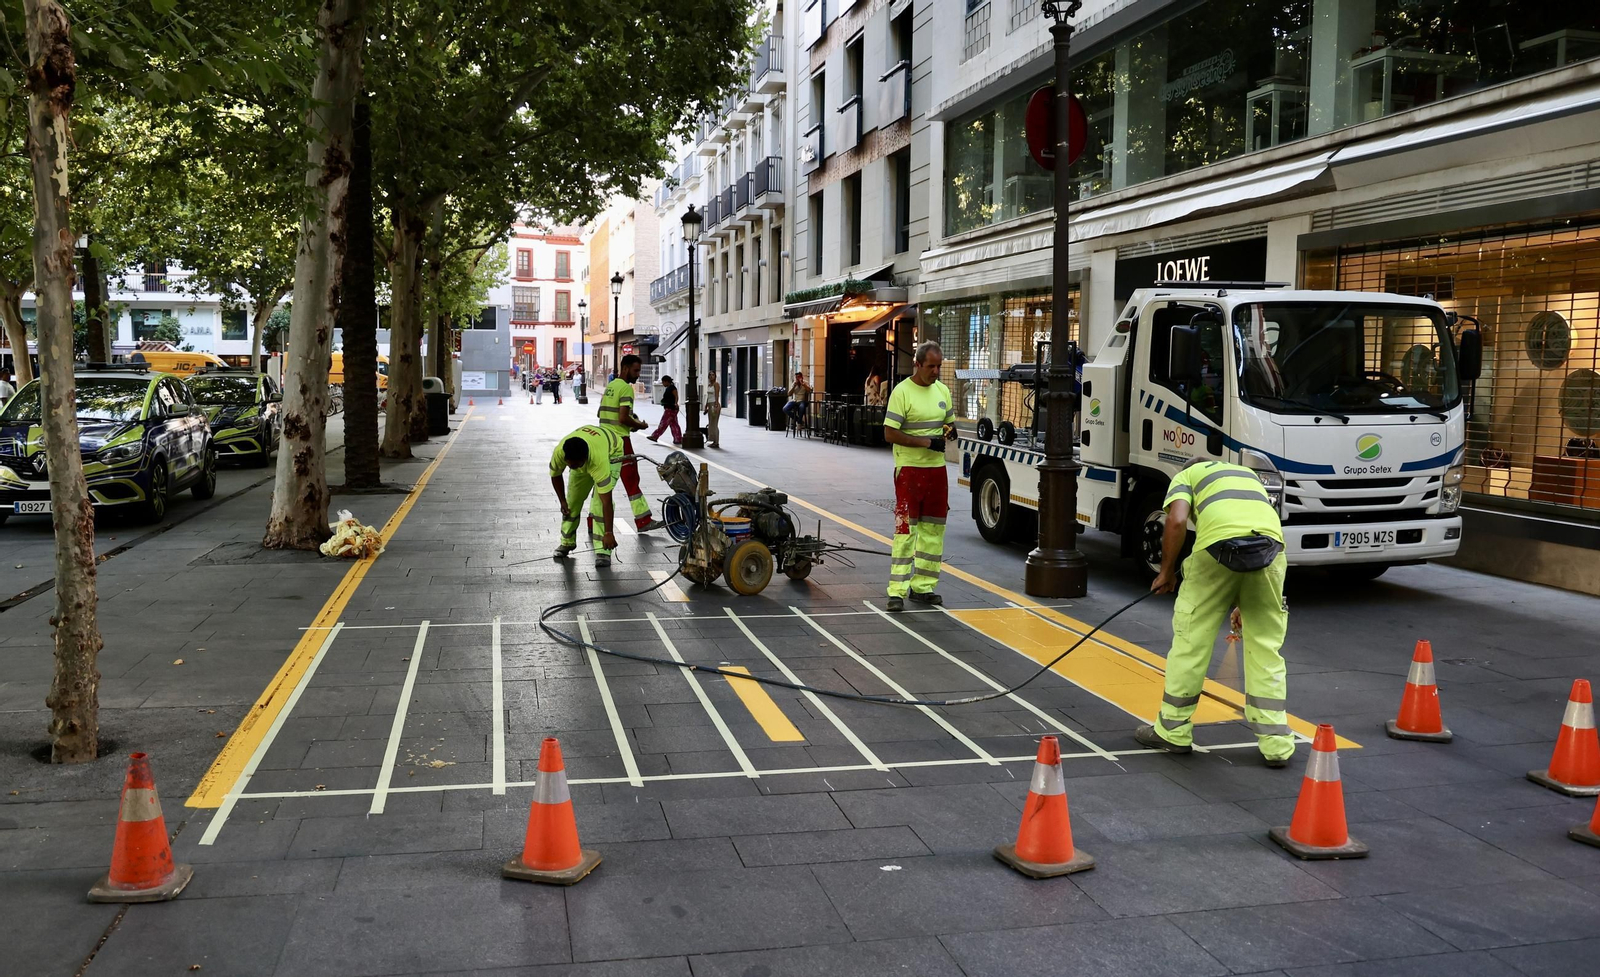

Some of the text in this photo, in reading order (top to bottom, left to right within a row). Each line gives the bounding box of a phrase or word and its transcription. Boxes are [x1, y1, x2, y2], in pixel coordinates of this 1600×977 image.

[1157, 255, 1211, 282] LOEWE
[1343, 465, 1392, 476] Grupo Setex
[20, 502, 46, 512] 0927
[1342, 530, 1394, 545] 7905 MZS
